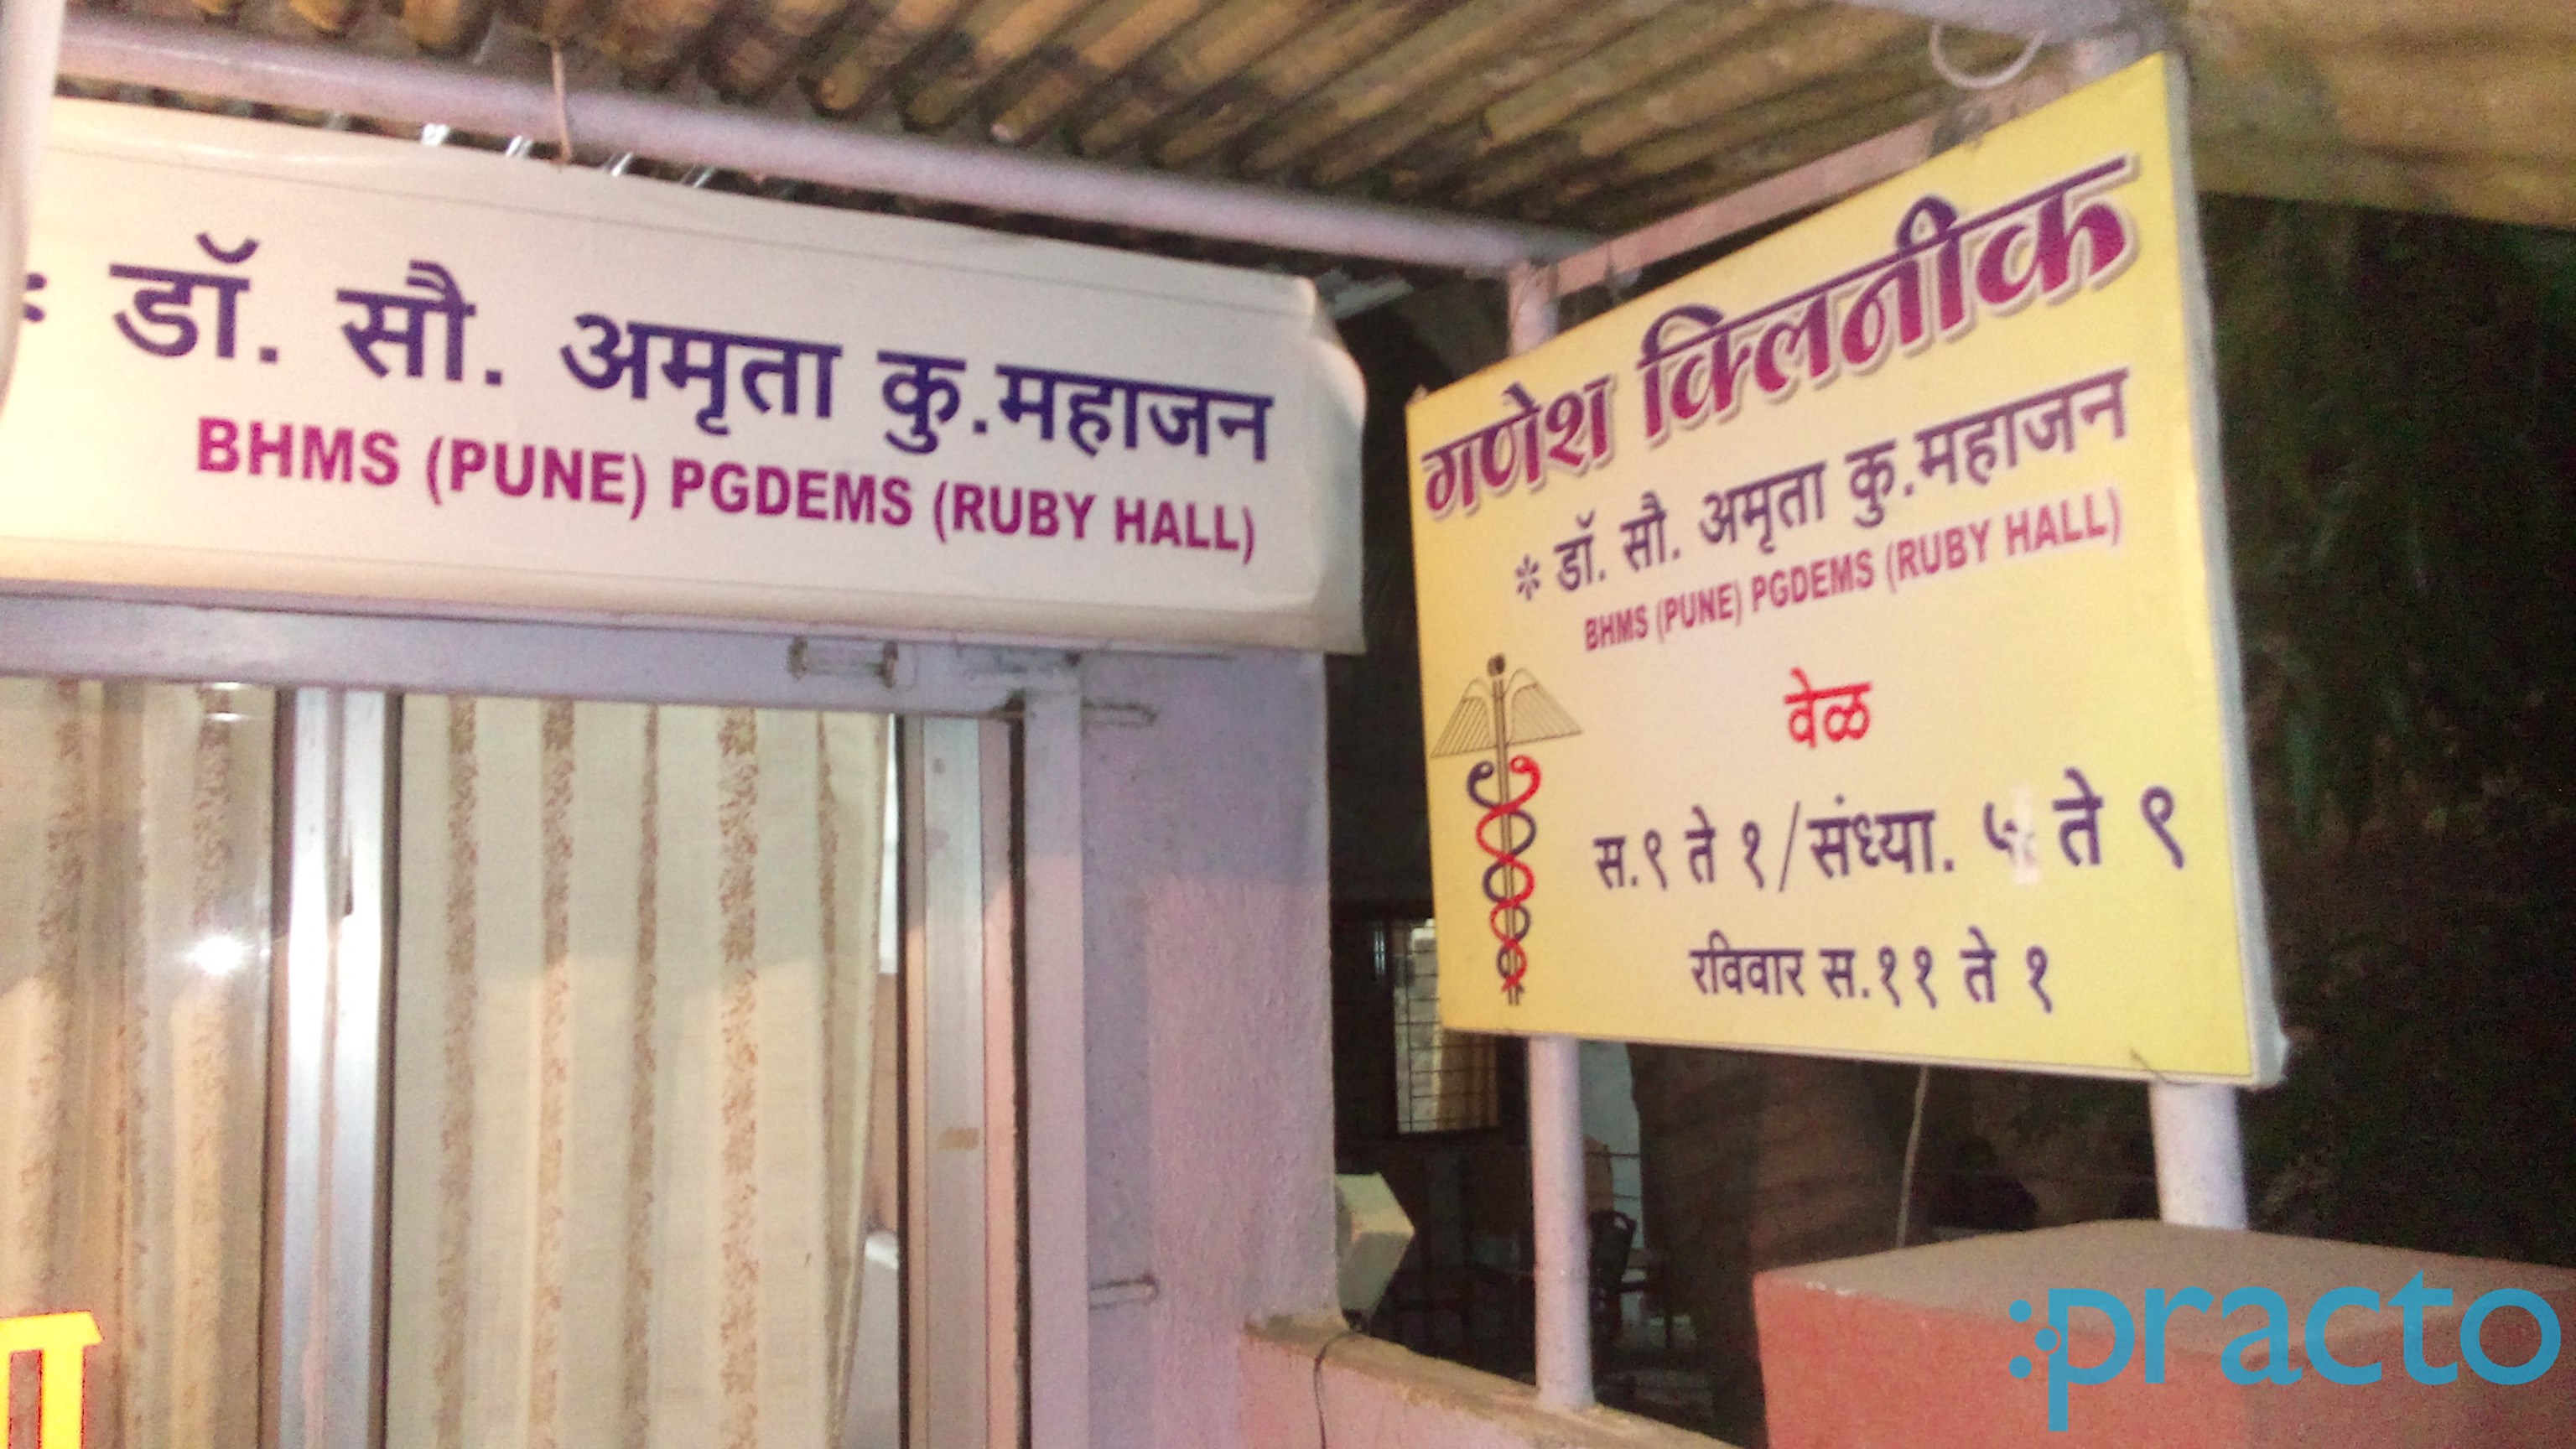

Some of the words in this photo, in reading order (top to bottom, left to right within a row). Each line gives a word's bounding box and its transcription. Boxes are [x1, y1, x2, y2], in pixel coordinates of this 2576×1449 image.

[109, 232, 280, 366] डॉ.
[336, 259, 503, 387] सौ.
[561, 313, 842, 437] अमृता
[877, 351, 1274, 463] कु.महाजन
[196, 416, 401, 487] BHMS
[426, 435, 647, 521] (PUNE)
[671, 457, 912, 528] PGDEMS
[933, 480, 1095, 543] (RUBY
[1115, 497, 1255, 565] HALL)
[1422, 377, 1615, 517] गणेश
[1554, 512, 1607, 593] डॉ.
[1621, 491, 1680, 574] सौ.
[1700, 460, 1826, 555] अमृता
[1846, 367, 2131, 527] कु.महाजन
[1584, 596, 1649, 652] BHMS
[1655, 581, 1744, 642] (PUNE)
[1752, 552, 1875, 615] PGDEMS
[1884, 523, 1990, 592] (RUBY
[2006, 487, 2122, 557] HALL)
[1784, 667, 1872, 749] वेळ
[1592, 833, 1670, 892] स.९
[1685, 805, 1716, 886] ते
[2053, 766, 2103, 867] ते
[2139, 784, 2184, 870] ९
[1689, 928, 1805, 999] रविवार
[1820, 946, 1939, 1012] स.११
[1959, 925, 1997, 1004] ते
[2025, 944, 2054, 1013] १
